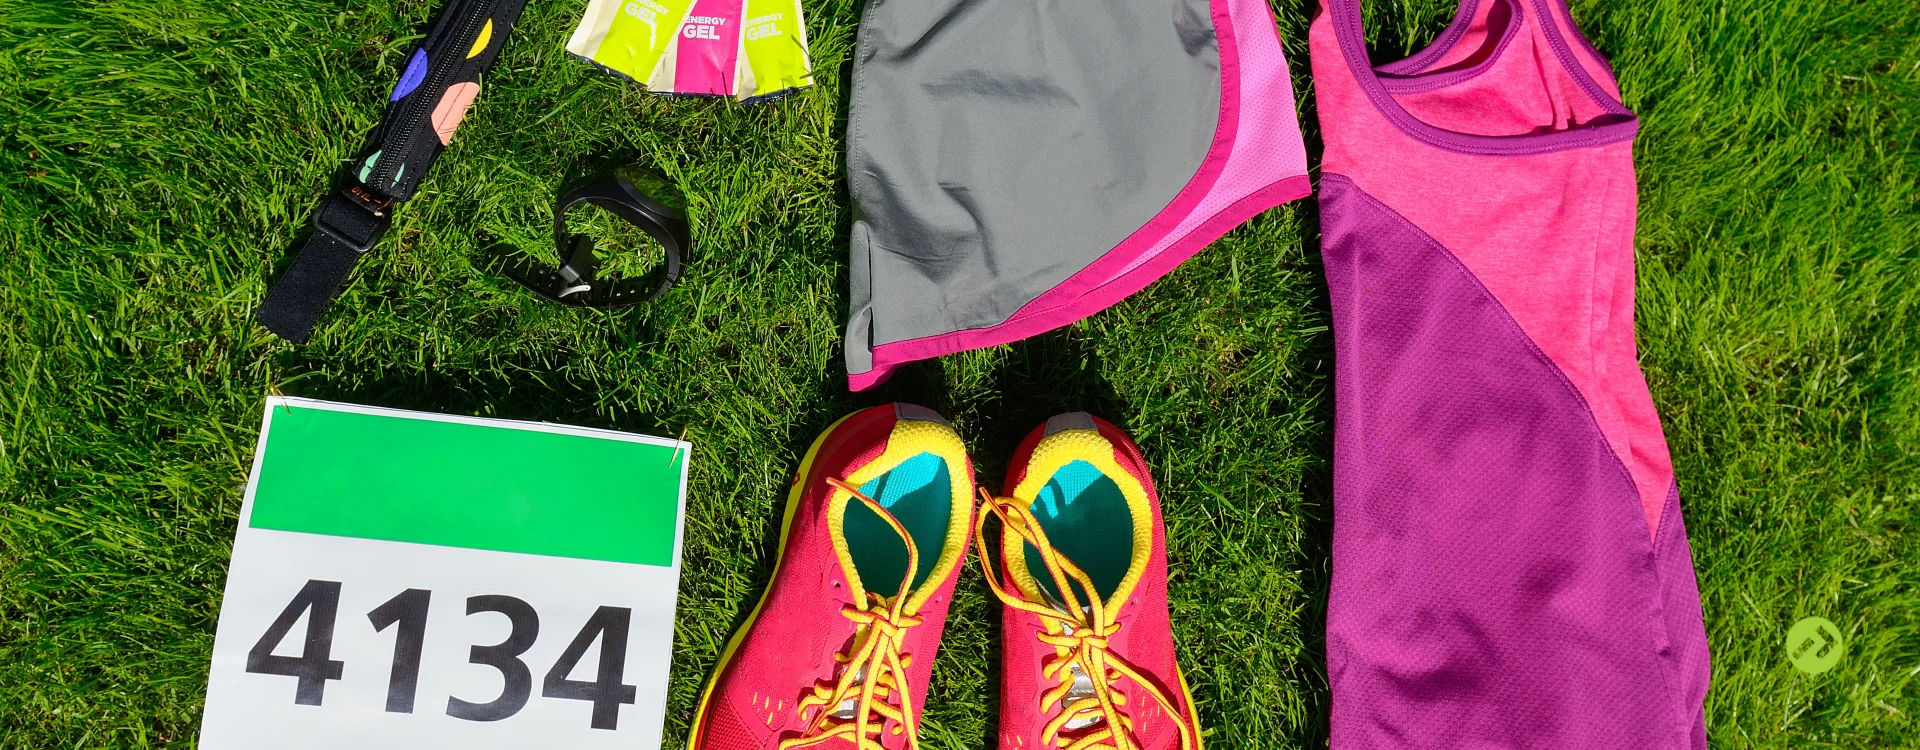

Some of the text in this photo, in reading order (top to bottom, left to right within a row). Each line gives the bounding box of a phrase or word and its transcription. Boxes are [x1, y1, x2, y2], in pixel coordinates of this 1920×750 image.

[625, 2, 657, 28] GEL
[635, 0, 669, 15] ERGY
[686, 16, 726, 25] ENERGY
[683, 24, 720, 40] GEL
[746, 23, 783, 41] GEL
[245, 579, 637, 731] 4134
